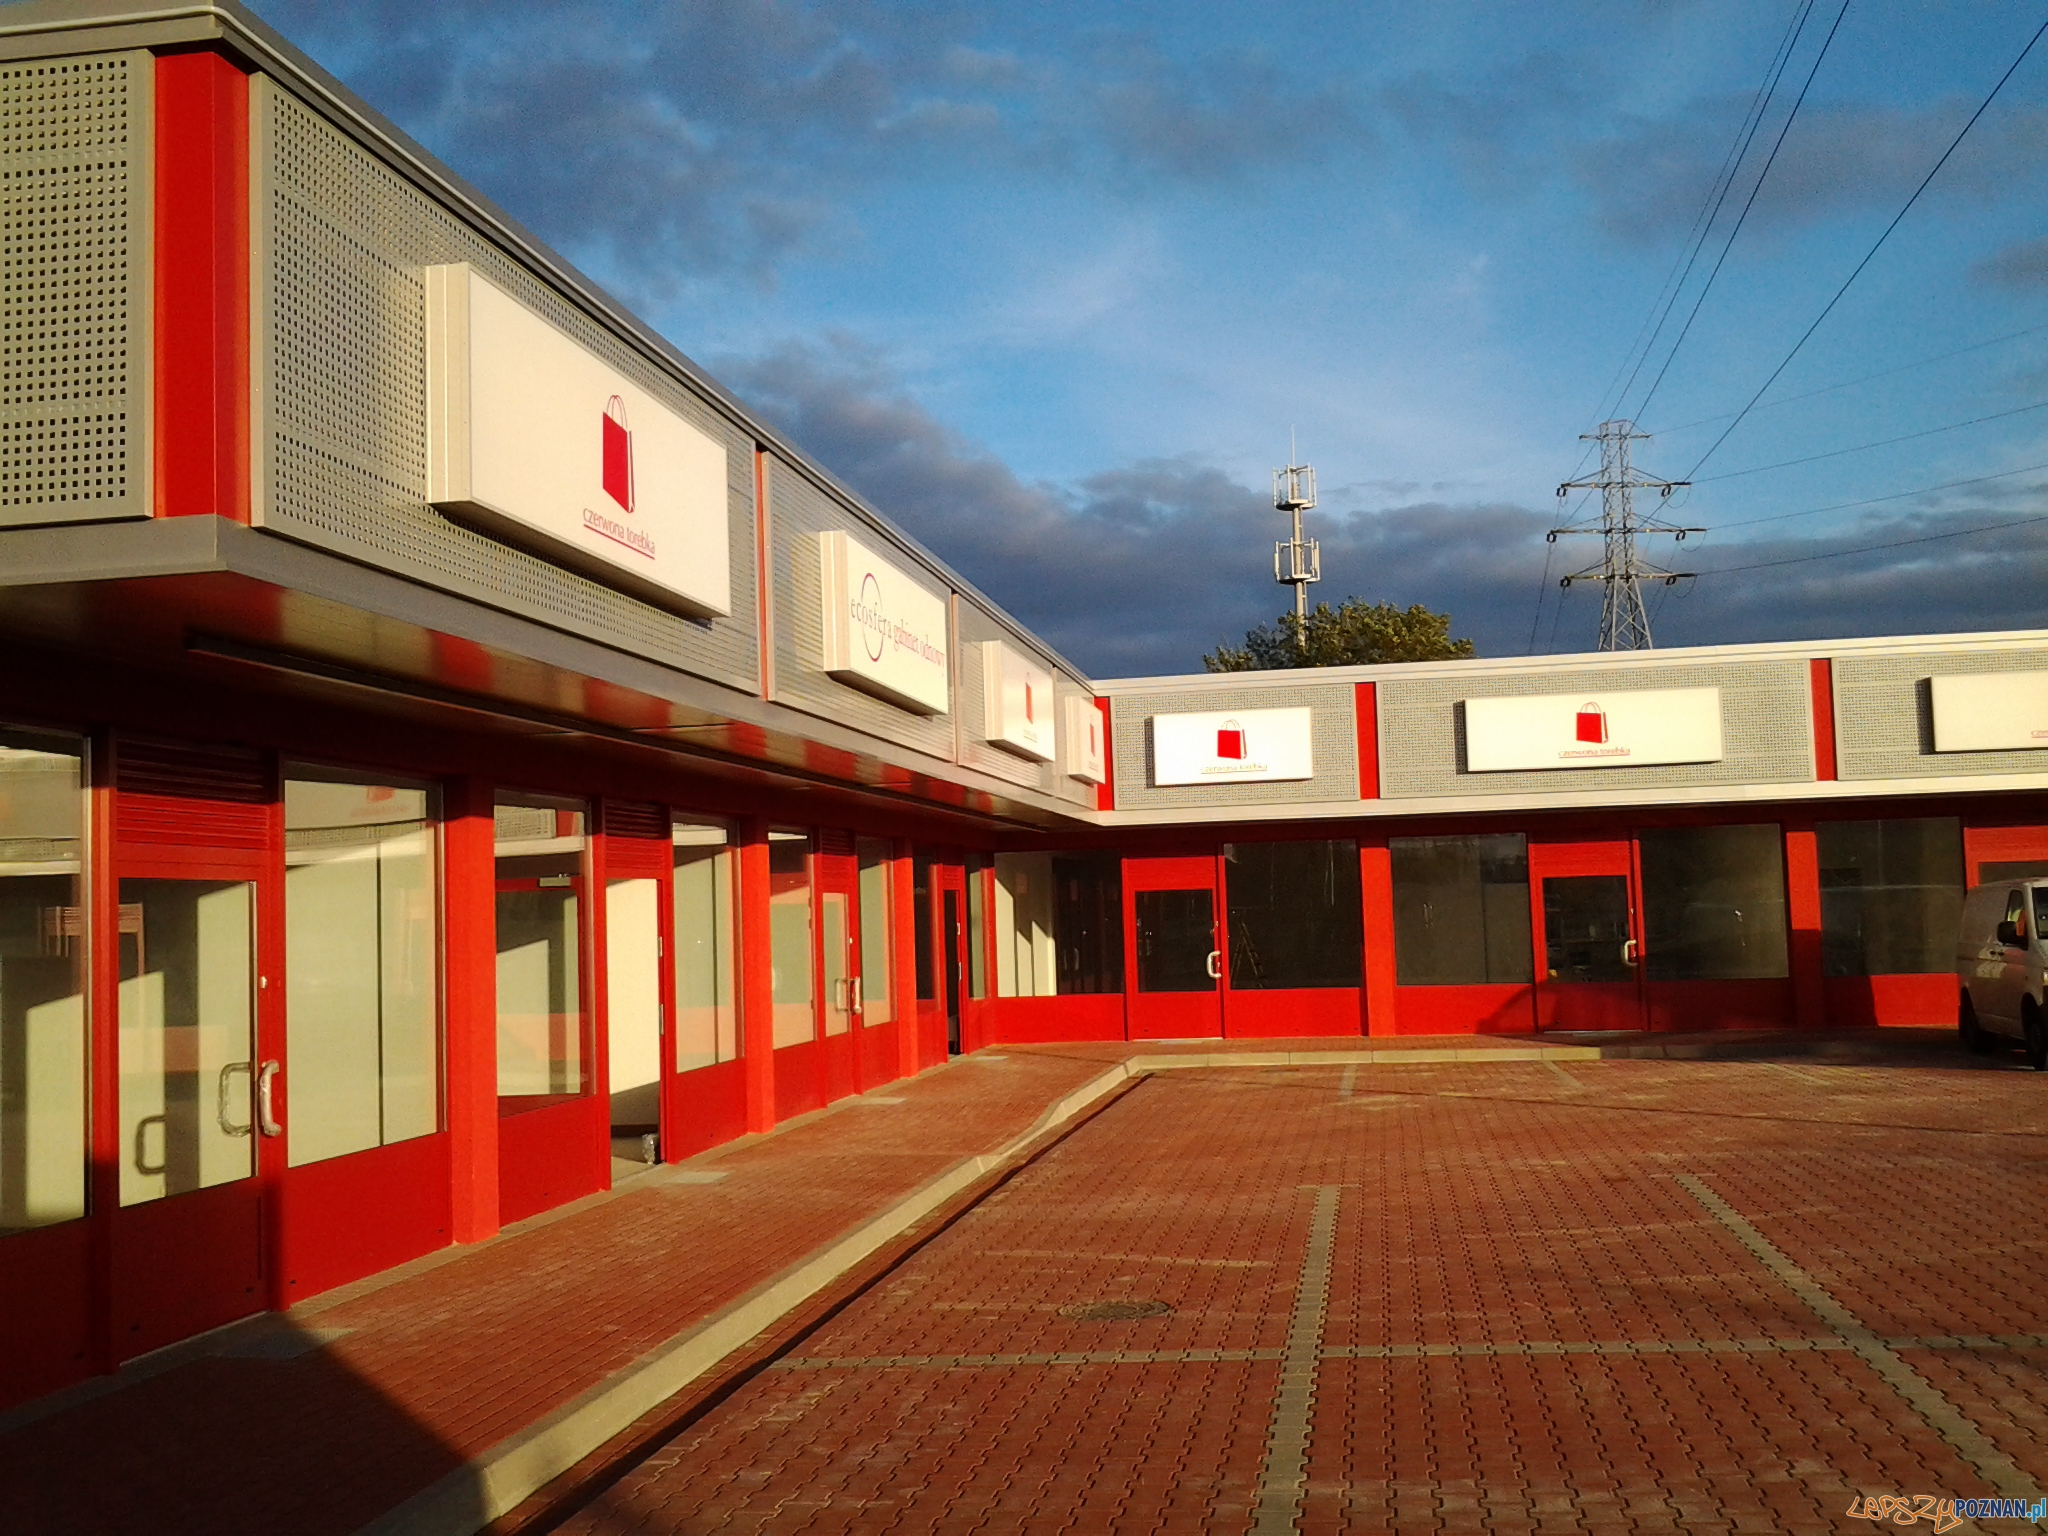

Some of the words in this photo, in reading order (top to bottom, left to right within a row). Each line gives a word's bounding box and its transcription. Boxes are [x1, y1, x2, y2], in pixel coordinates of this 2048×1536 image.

[583, 507, 624, 539] czerwona
[626, 526, 656, 555] torebka
[850, 598, 892, 639] ecosfera
